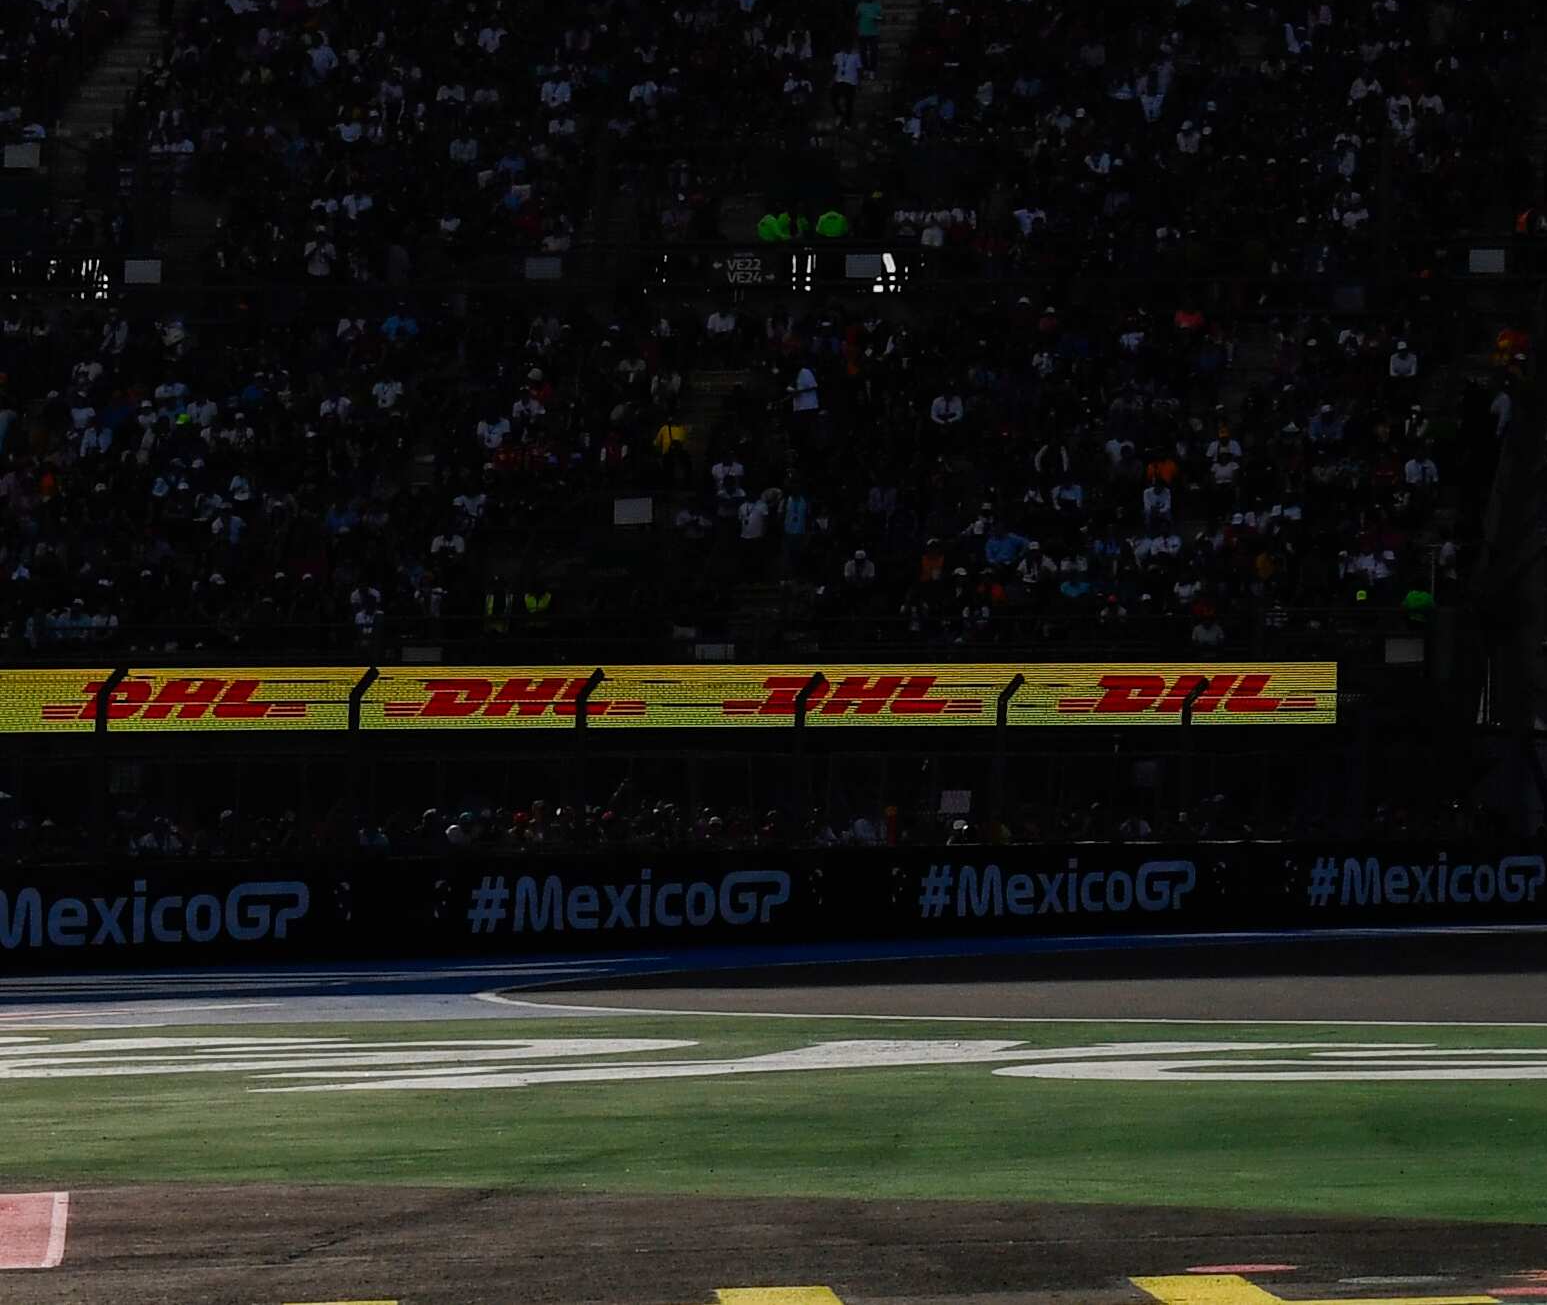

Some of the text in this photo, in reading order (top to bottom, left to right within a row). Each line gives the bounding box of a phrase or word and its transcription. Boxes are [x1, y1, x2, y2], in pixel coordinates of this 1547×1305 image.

[726, 258, 762, 271] VE22
[726, 270, 763, 284] VE24
[82, 681, 268, 718] DHL
[422, 679, 604, 716] DHL
[761, 677, 944, 714] DHL
[1097, 675, 1280, 712] DHL
[467, 868, 792, 935] #MexicoGP
[917, 856, 1198, 920] #MexicoGP
